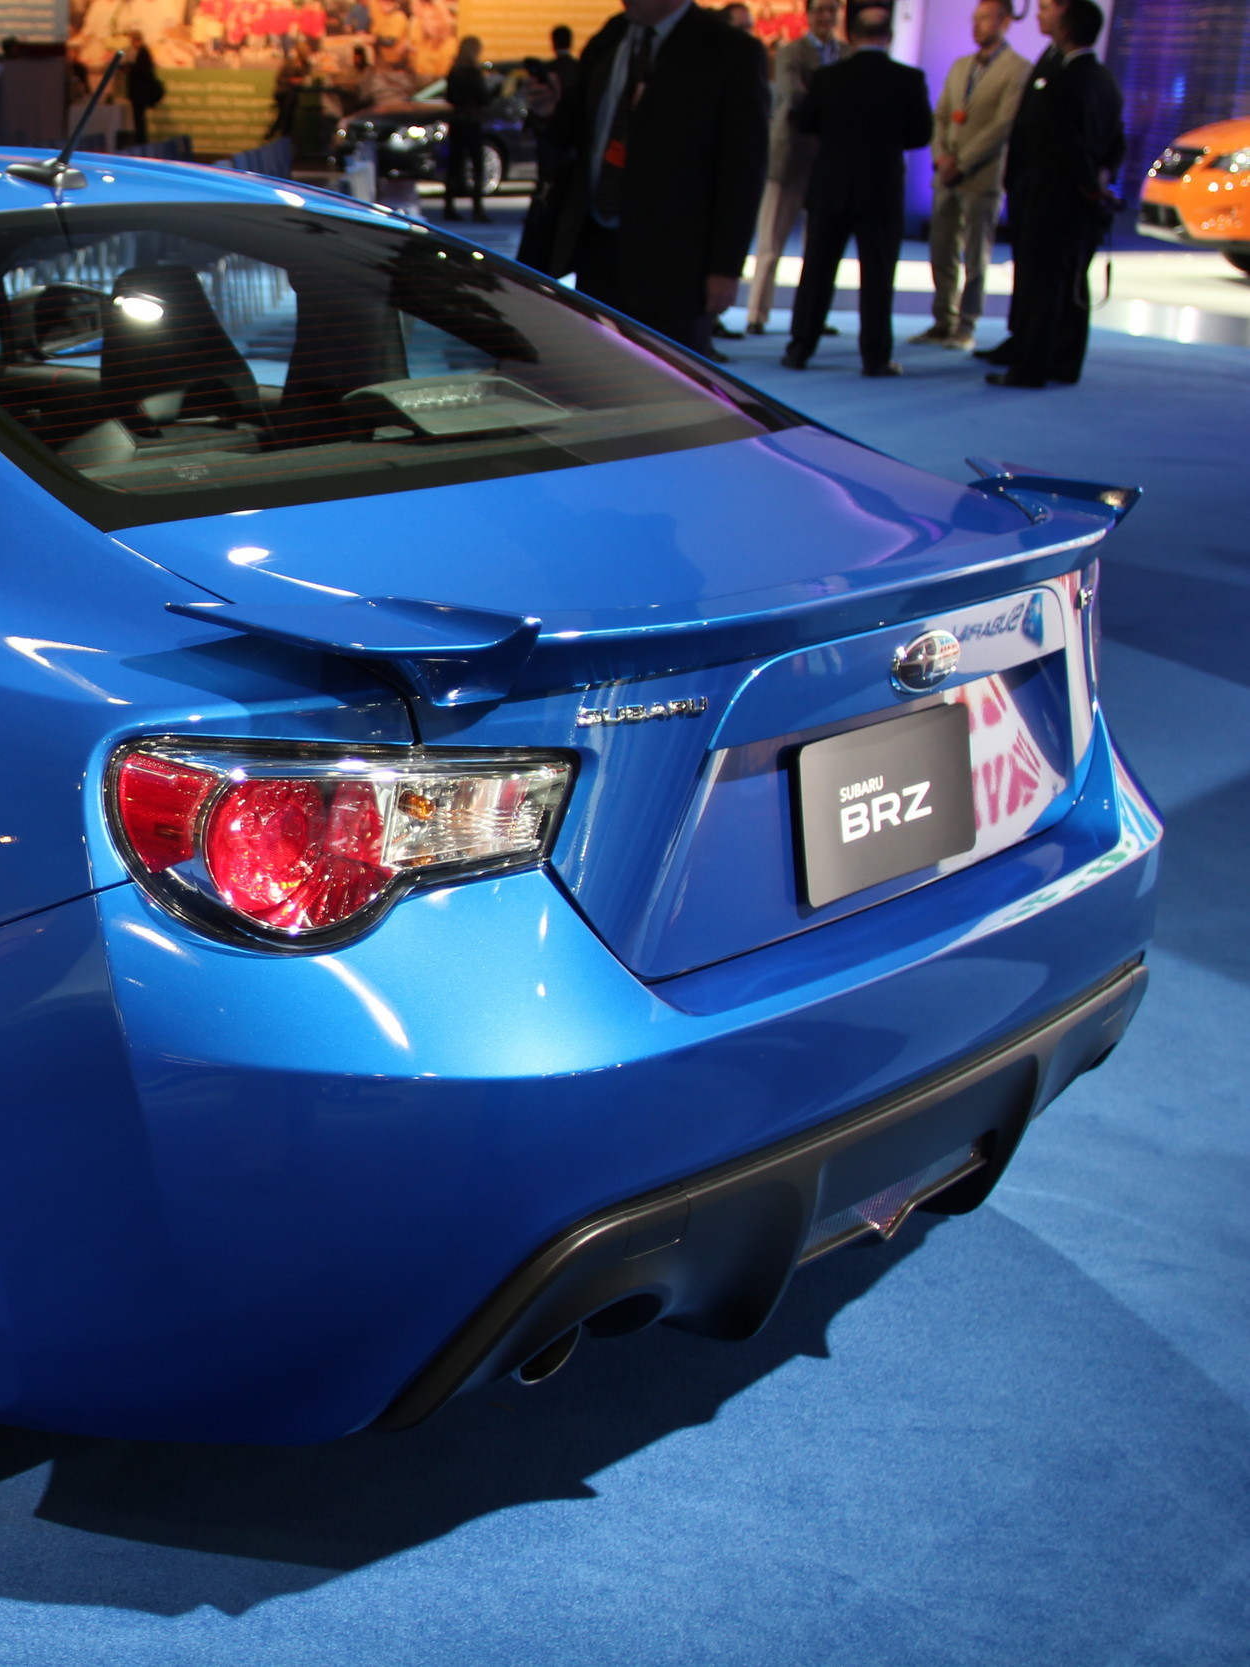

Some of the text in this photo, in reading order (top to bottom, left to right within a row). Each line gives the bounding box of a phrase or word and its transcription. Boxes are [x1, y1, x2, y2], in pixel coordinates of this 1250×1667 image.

[576, 696, 708, 725] SUBARU
[839, 775, 884, 803] SUBARU
[840, 780, 933, 844] BRZ
